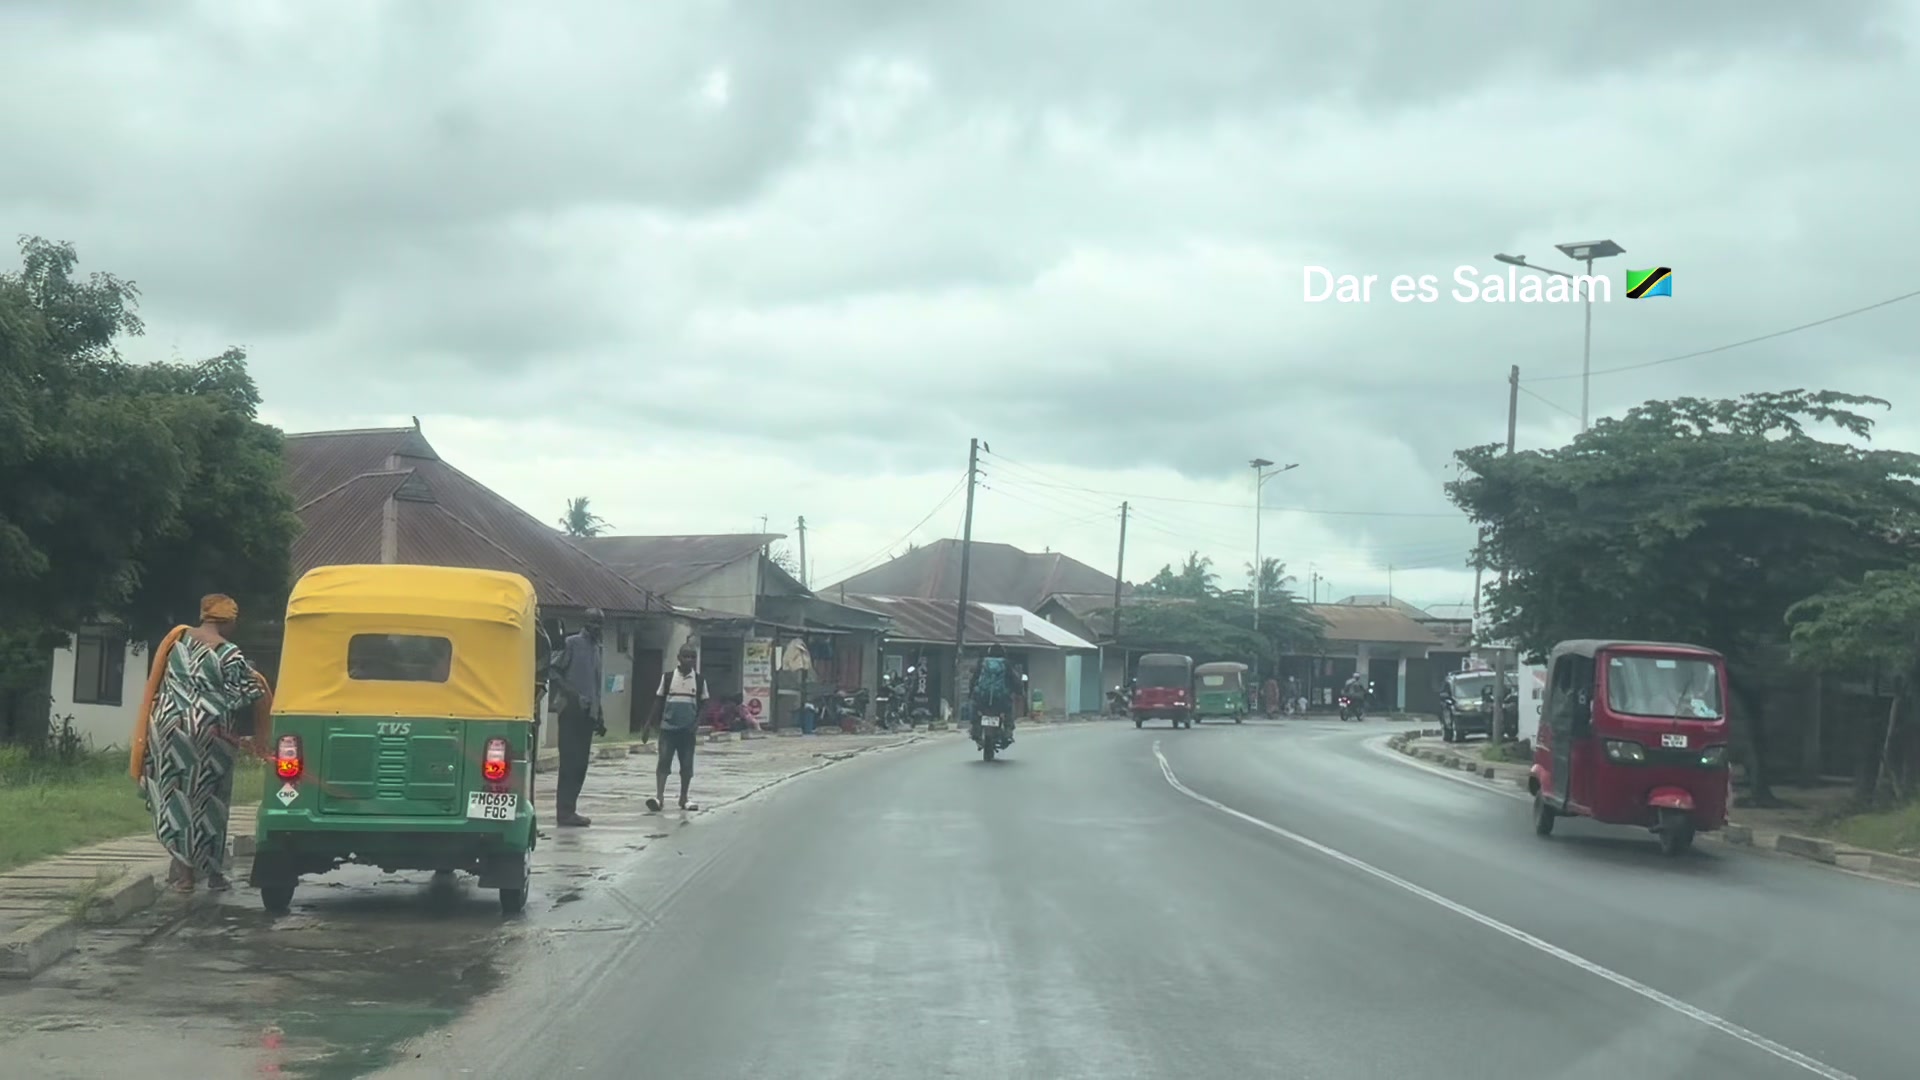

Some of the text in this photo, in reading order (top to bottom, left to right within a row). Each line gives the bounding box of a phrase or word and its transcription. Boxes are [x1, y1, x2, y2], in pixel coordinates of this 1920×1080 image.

[377, 722, 411, 735] TVS
[279, 790, 296, 798] CNG
[478, 793, 516, 807] MC693
[484, 806, 507, 818] FQC
